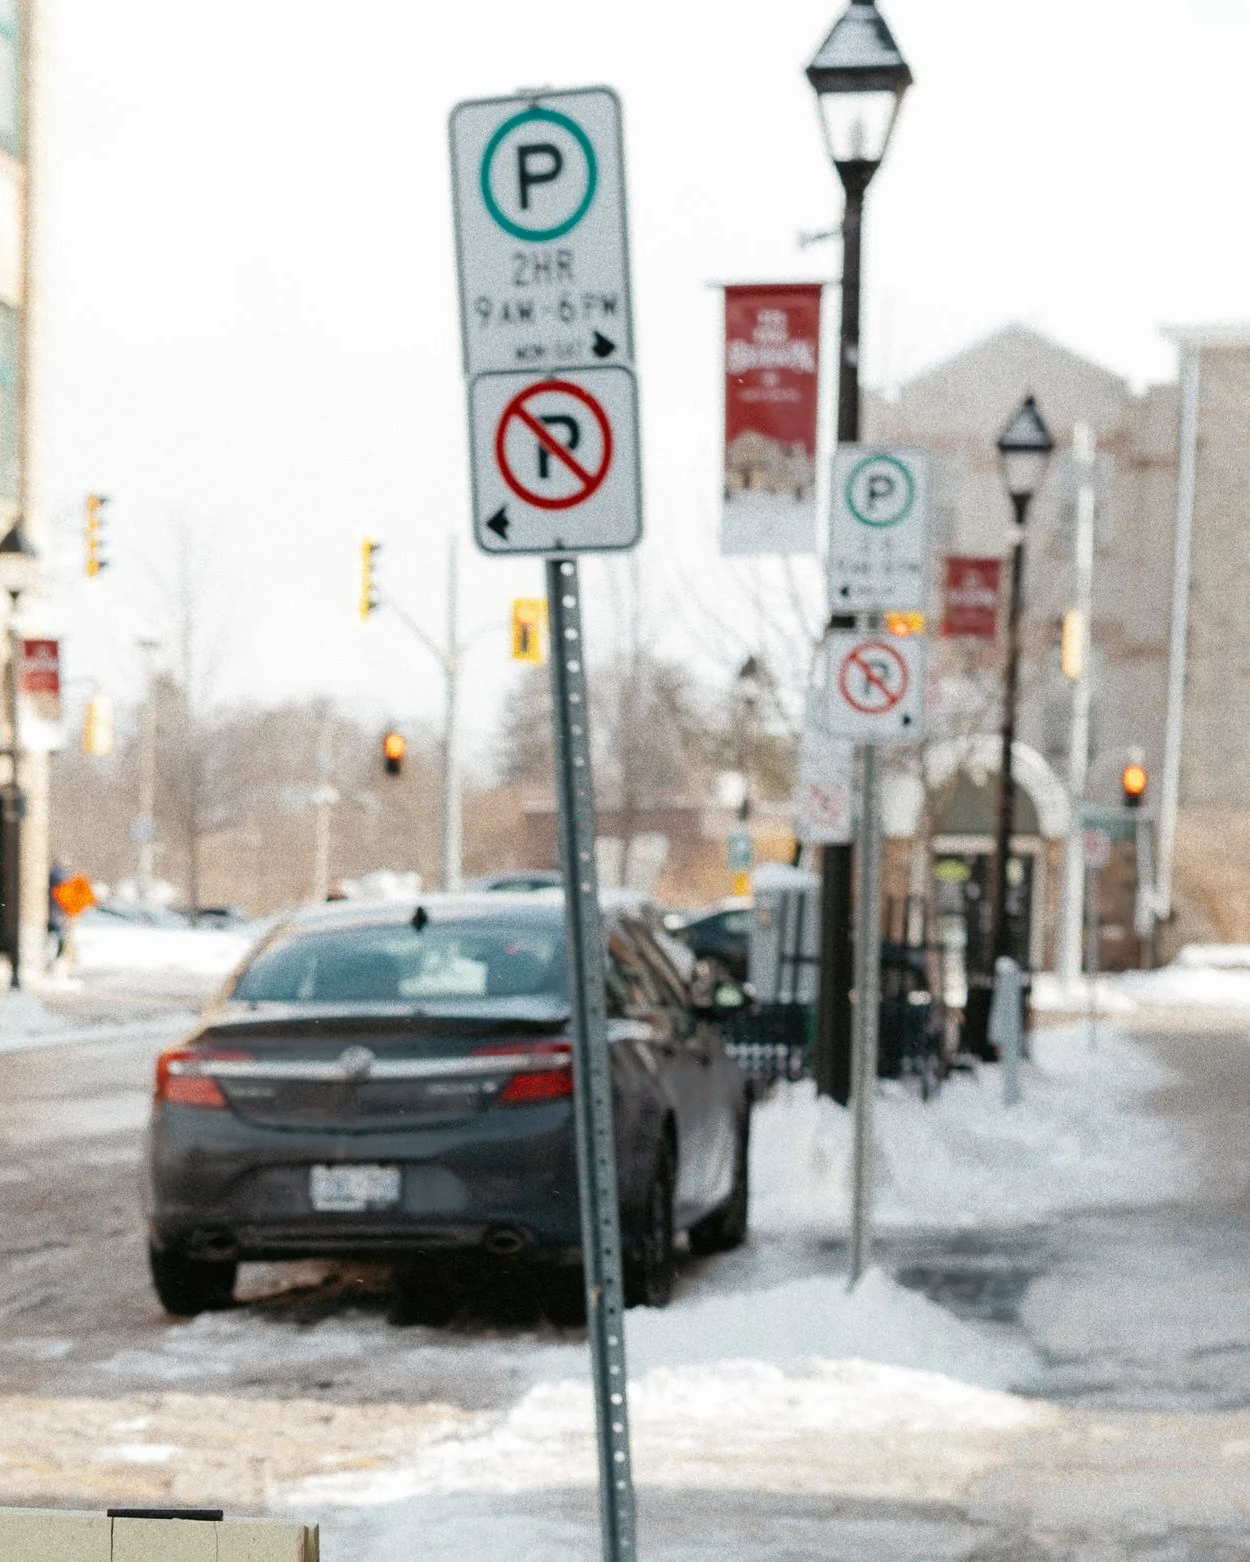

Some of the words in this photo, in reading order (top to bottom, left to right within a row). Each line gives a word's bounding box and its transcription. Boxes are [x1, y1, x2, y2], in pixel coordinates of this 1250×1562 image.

[516, 142, 564, 210] P
[512, 249, 574, 287] 2HR
[867, 475, 895, 511] P
